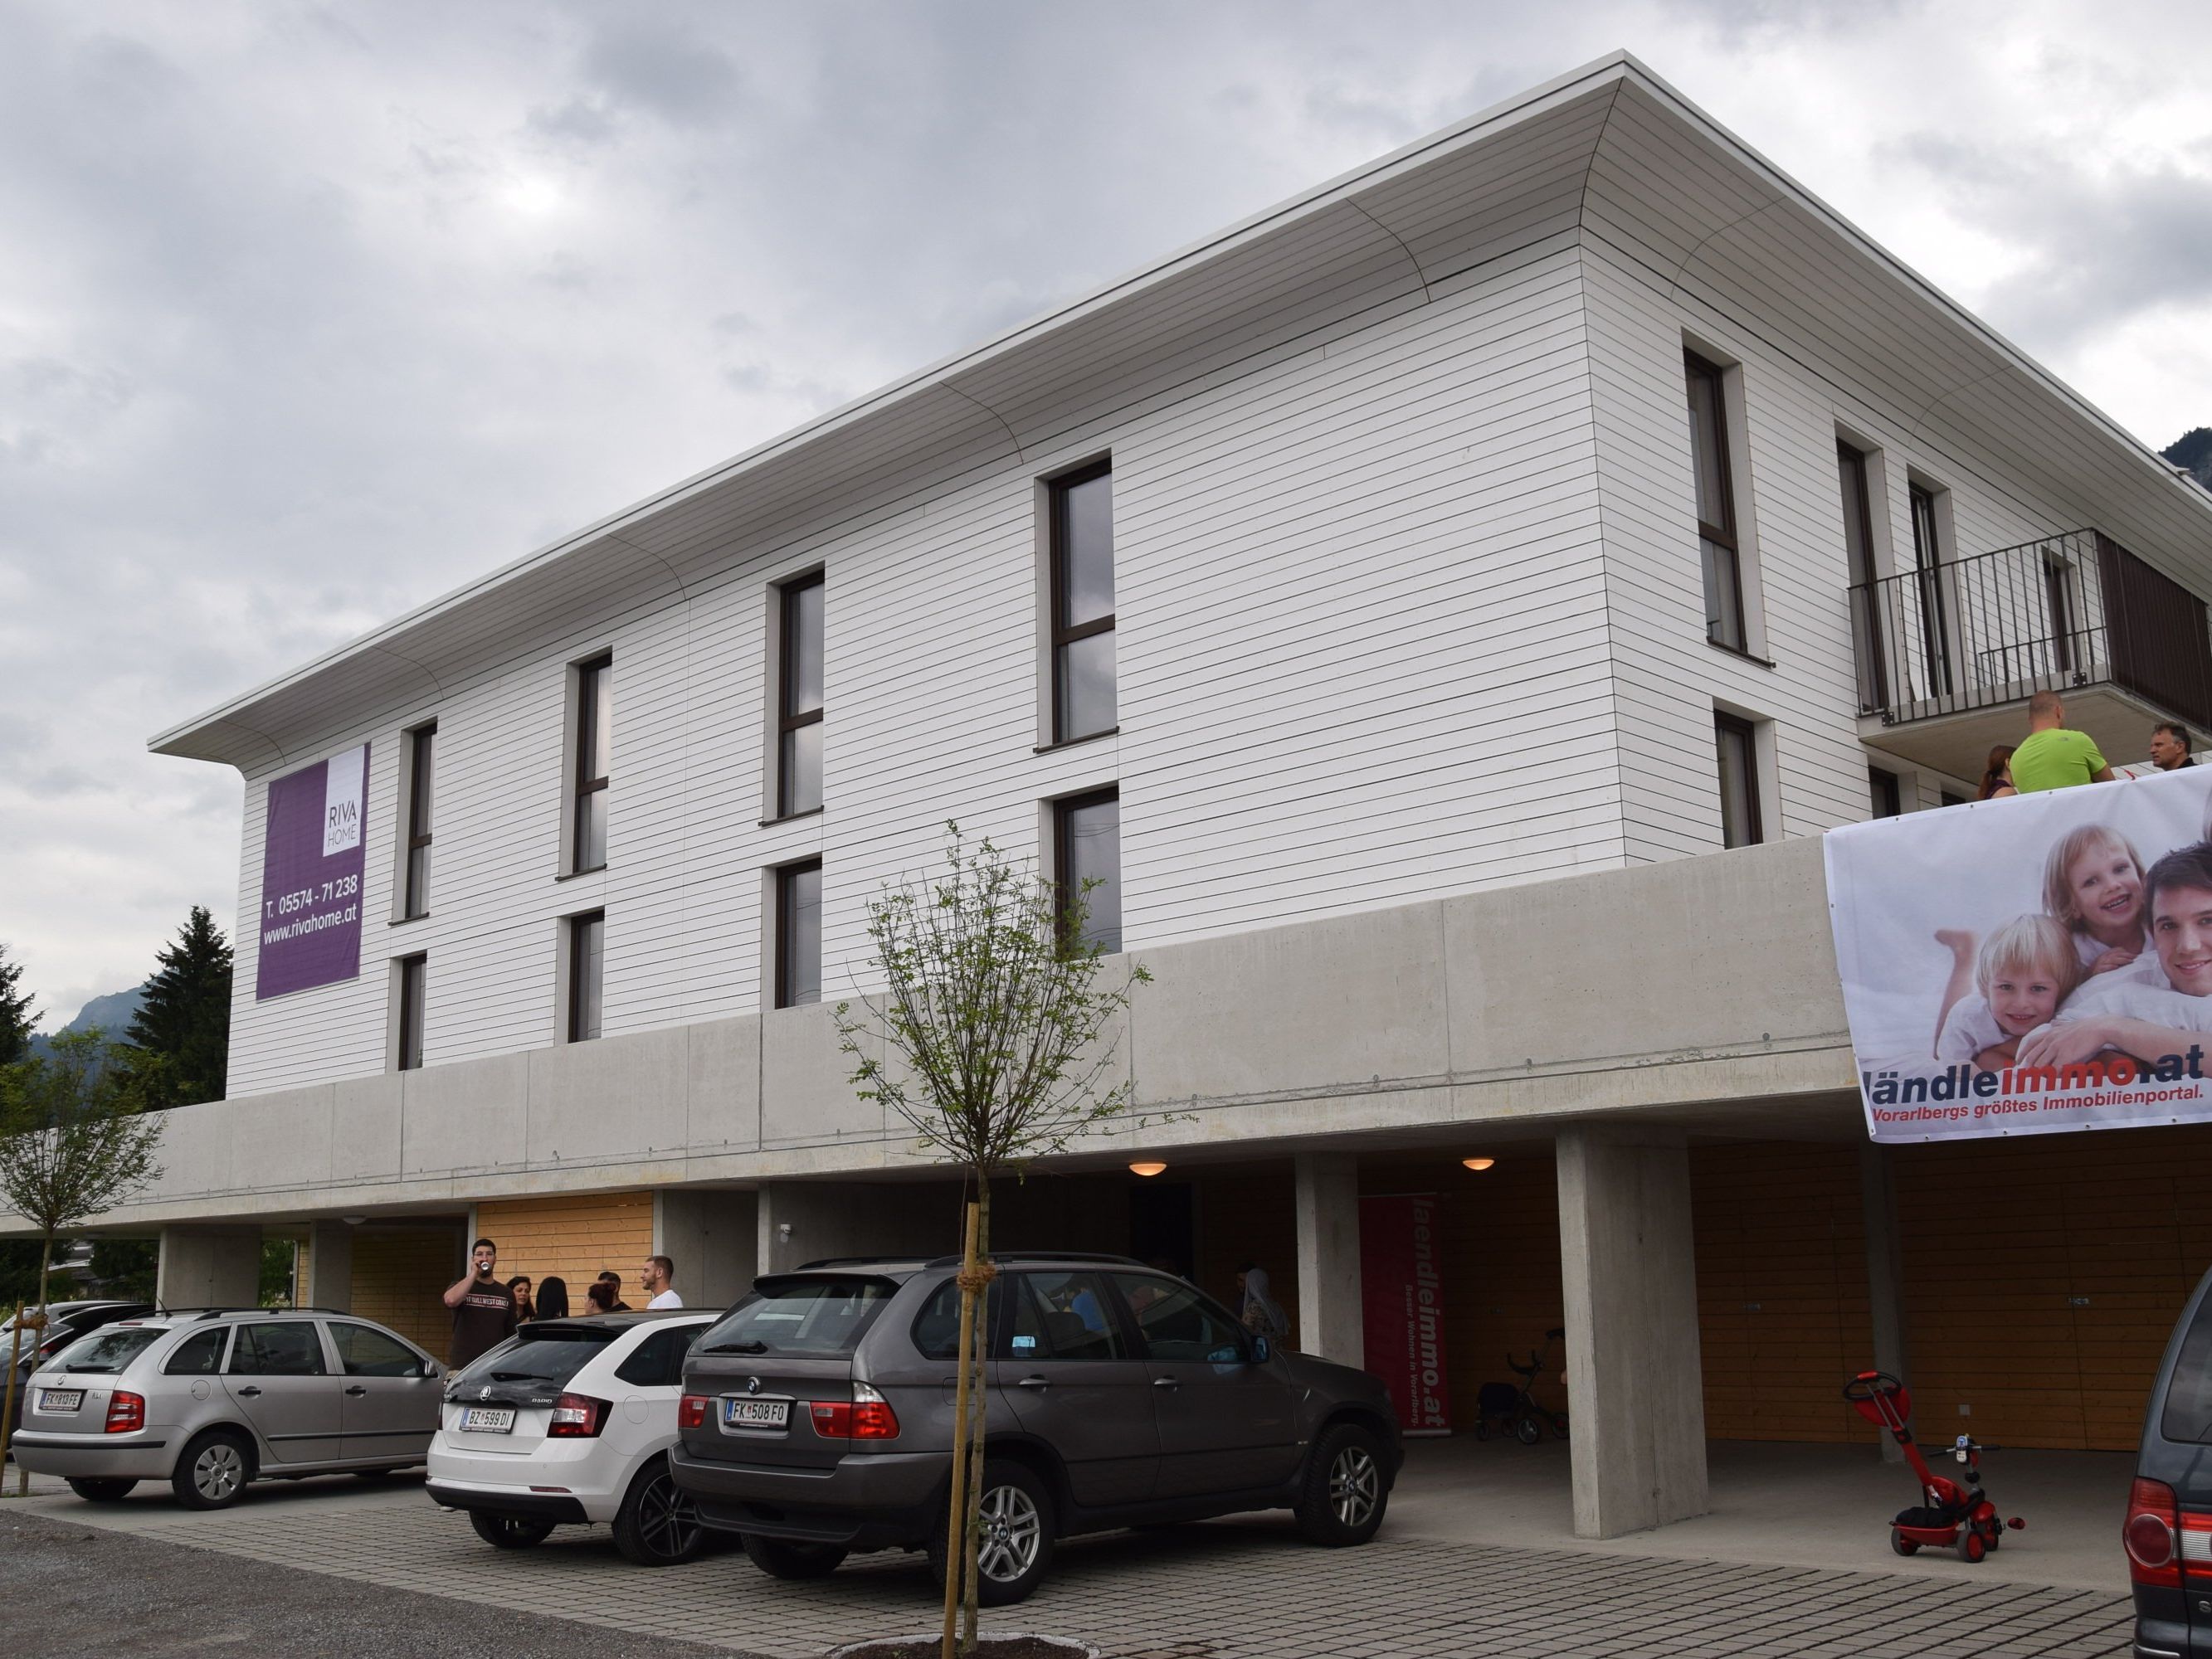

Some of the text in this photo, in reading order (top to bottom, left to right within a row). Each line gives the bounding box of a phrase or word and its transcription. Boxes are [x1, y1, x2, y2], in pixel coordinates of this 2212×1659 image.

[329, 800, 357, 828] RIVA
[328, 824, 357, 847] HOME
[266, 901, 274, 919] T.
[279, 888, 313, 915] 05574
[322, 882, 333, 902] 71
[335, 874, 358, 898] 238
[264, 902, 357, 945] www.rivahome.at
[1873, 1084, 2204, 1122] Vorarlbergs größtes Immobilienportal.
[1413, 1199, 1442, 1427] laendleimmo.at
[1405, 1284, 1420, 1427] Besser Wohnen in Vorarlberg.
[469, 1411, 480, 1424] BZ
[733, 1403, 746, 1418] FK
